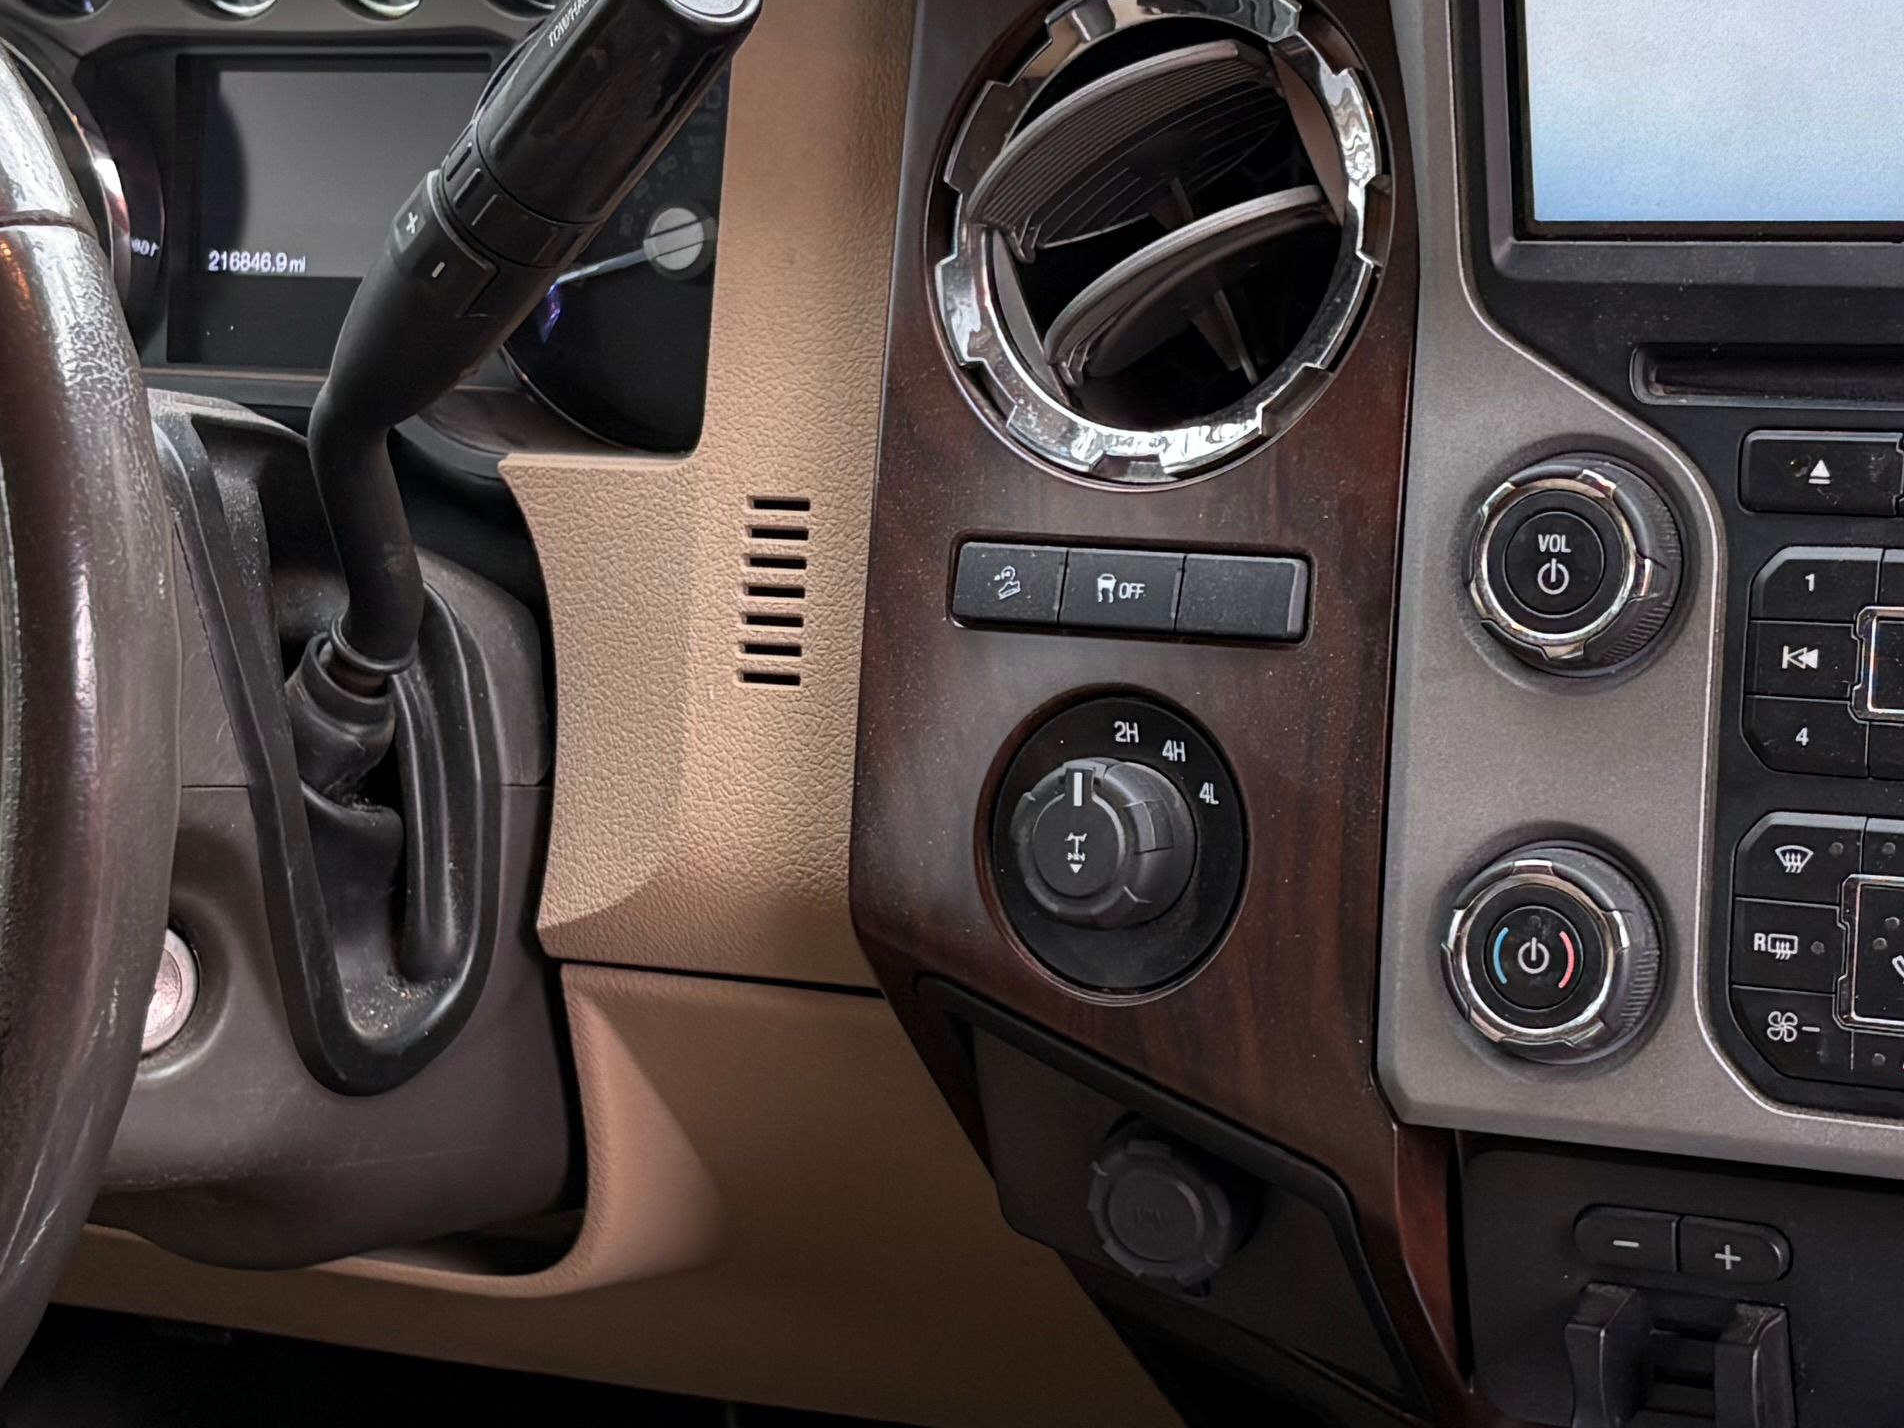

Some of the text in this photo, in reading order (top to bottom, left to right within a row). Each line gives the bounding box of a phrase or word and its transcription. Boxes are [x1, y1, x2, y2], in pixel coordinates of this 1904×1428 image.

[208, 250, 287, 272] 216846.9
[1538, 534, 1571, 552] VOL
[1118, 583, 1145, 600] OFF
[1805, 574, 1815, 591] 1
[1114, 721, 1140, 744] 2H
[1796, 728, 1809, 745] 4
[1162, 739, 1187, 762] 4H
[1199, 782, 1219, 805] 4L
